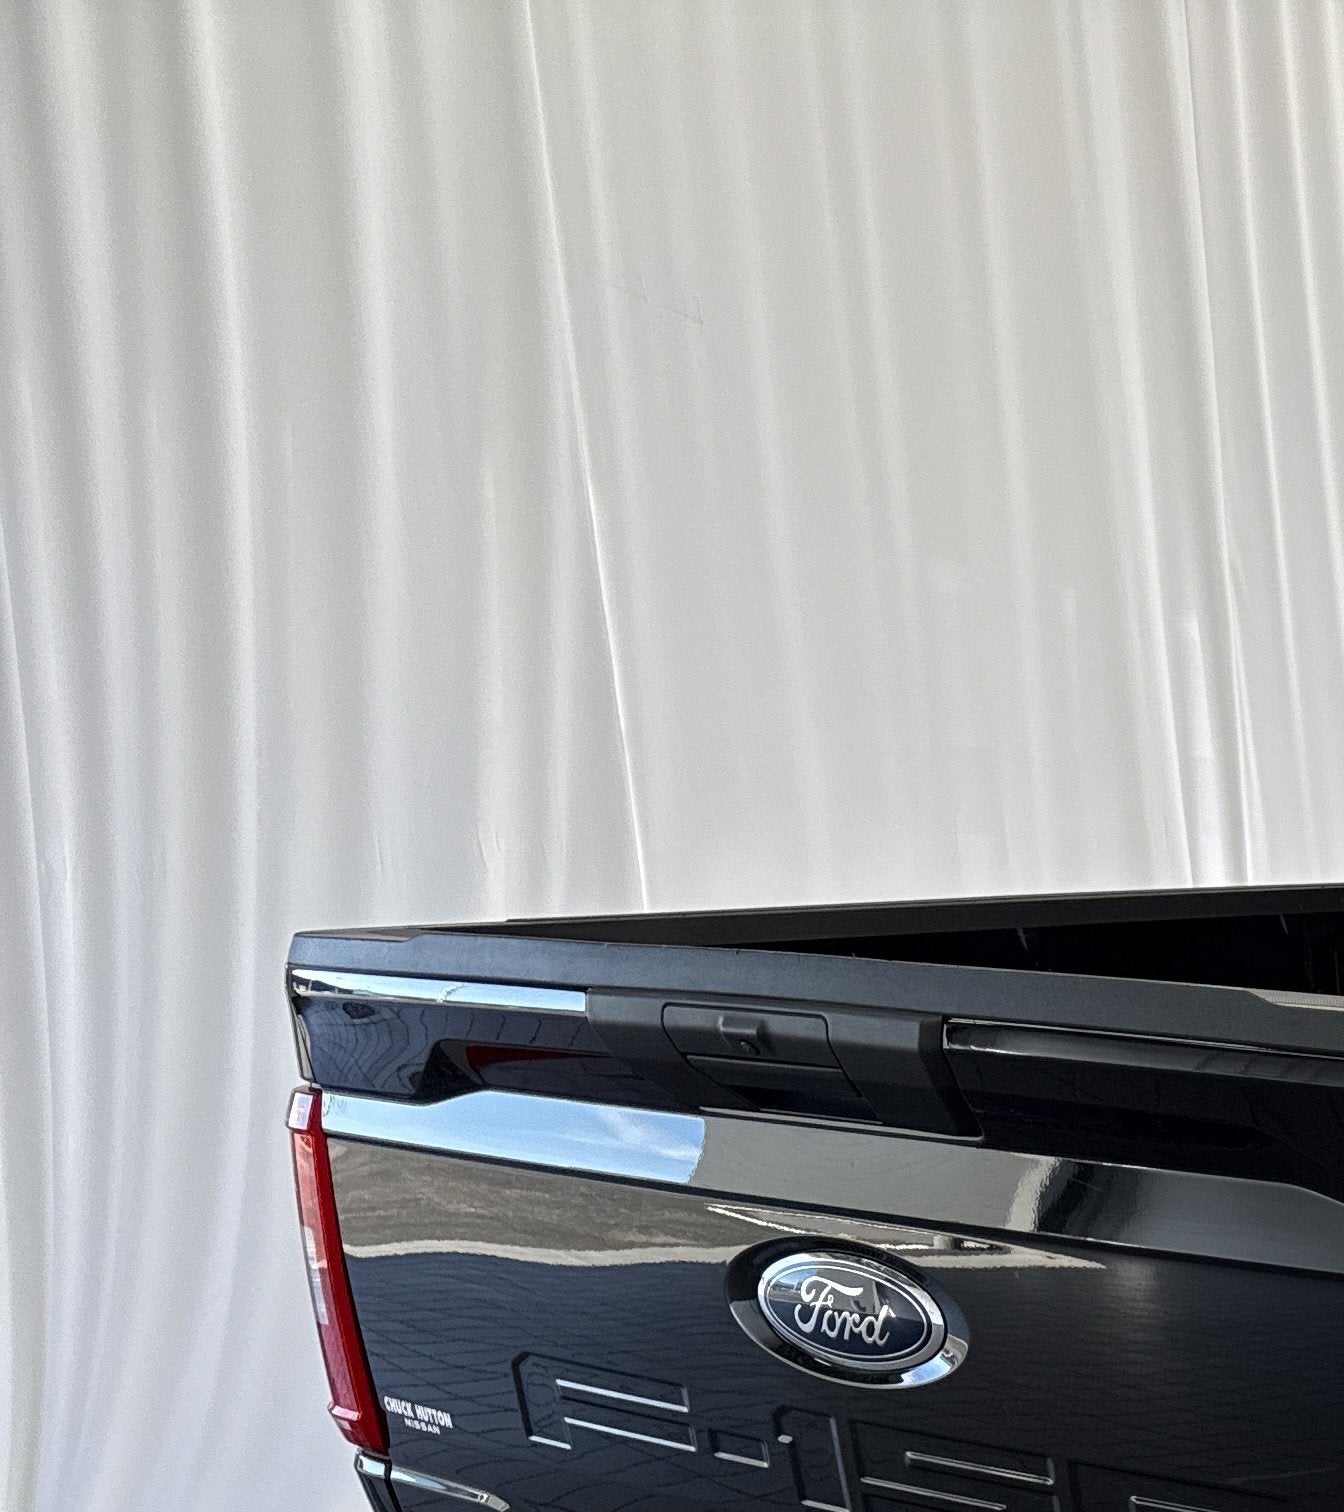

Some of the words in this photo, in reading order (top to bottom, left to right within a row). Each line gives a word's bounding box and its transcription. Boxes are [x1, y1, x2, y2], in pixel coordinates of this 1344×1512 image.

[794, 1276, 896, 1347] Ford
[383, 1395, 415, 1418] CHUCK
[414, 1403, 453, 1429] HUTTON
[404, 1417, 440, 1435] NISSAN
